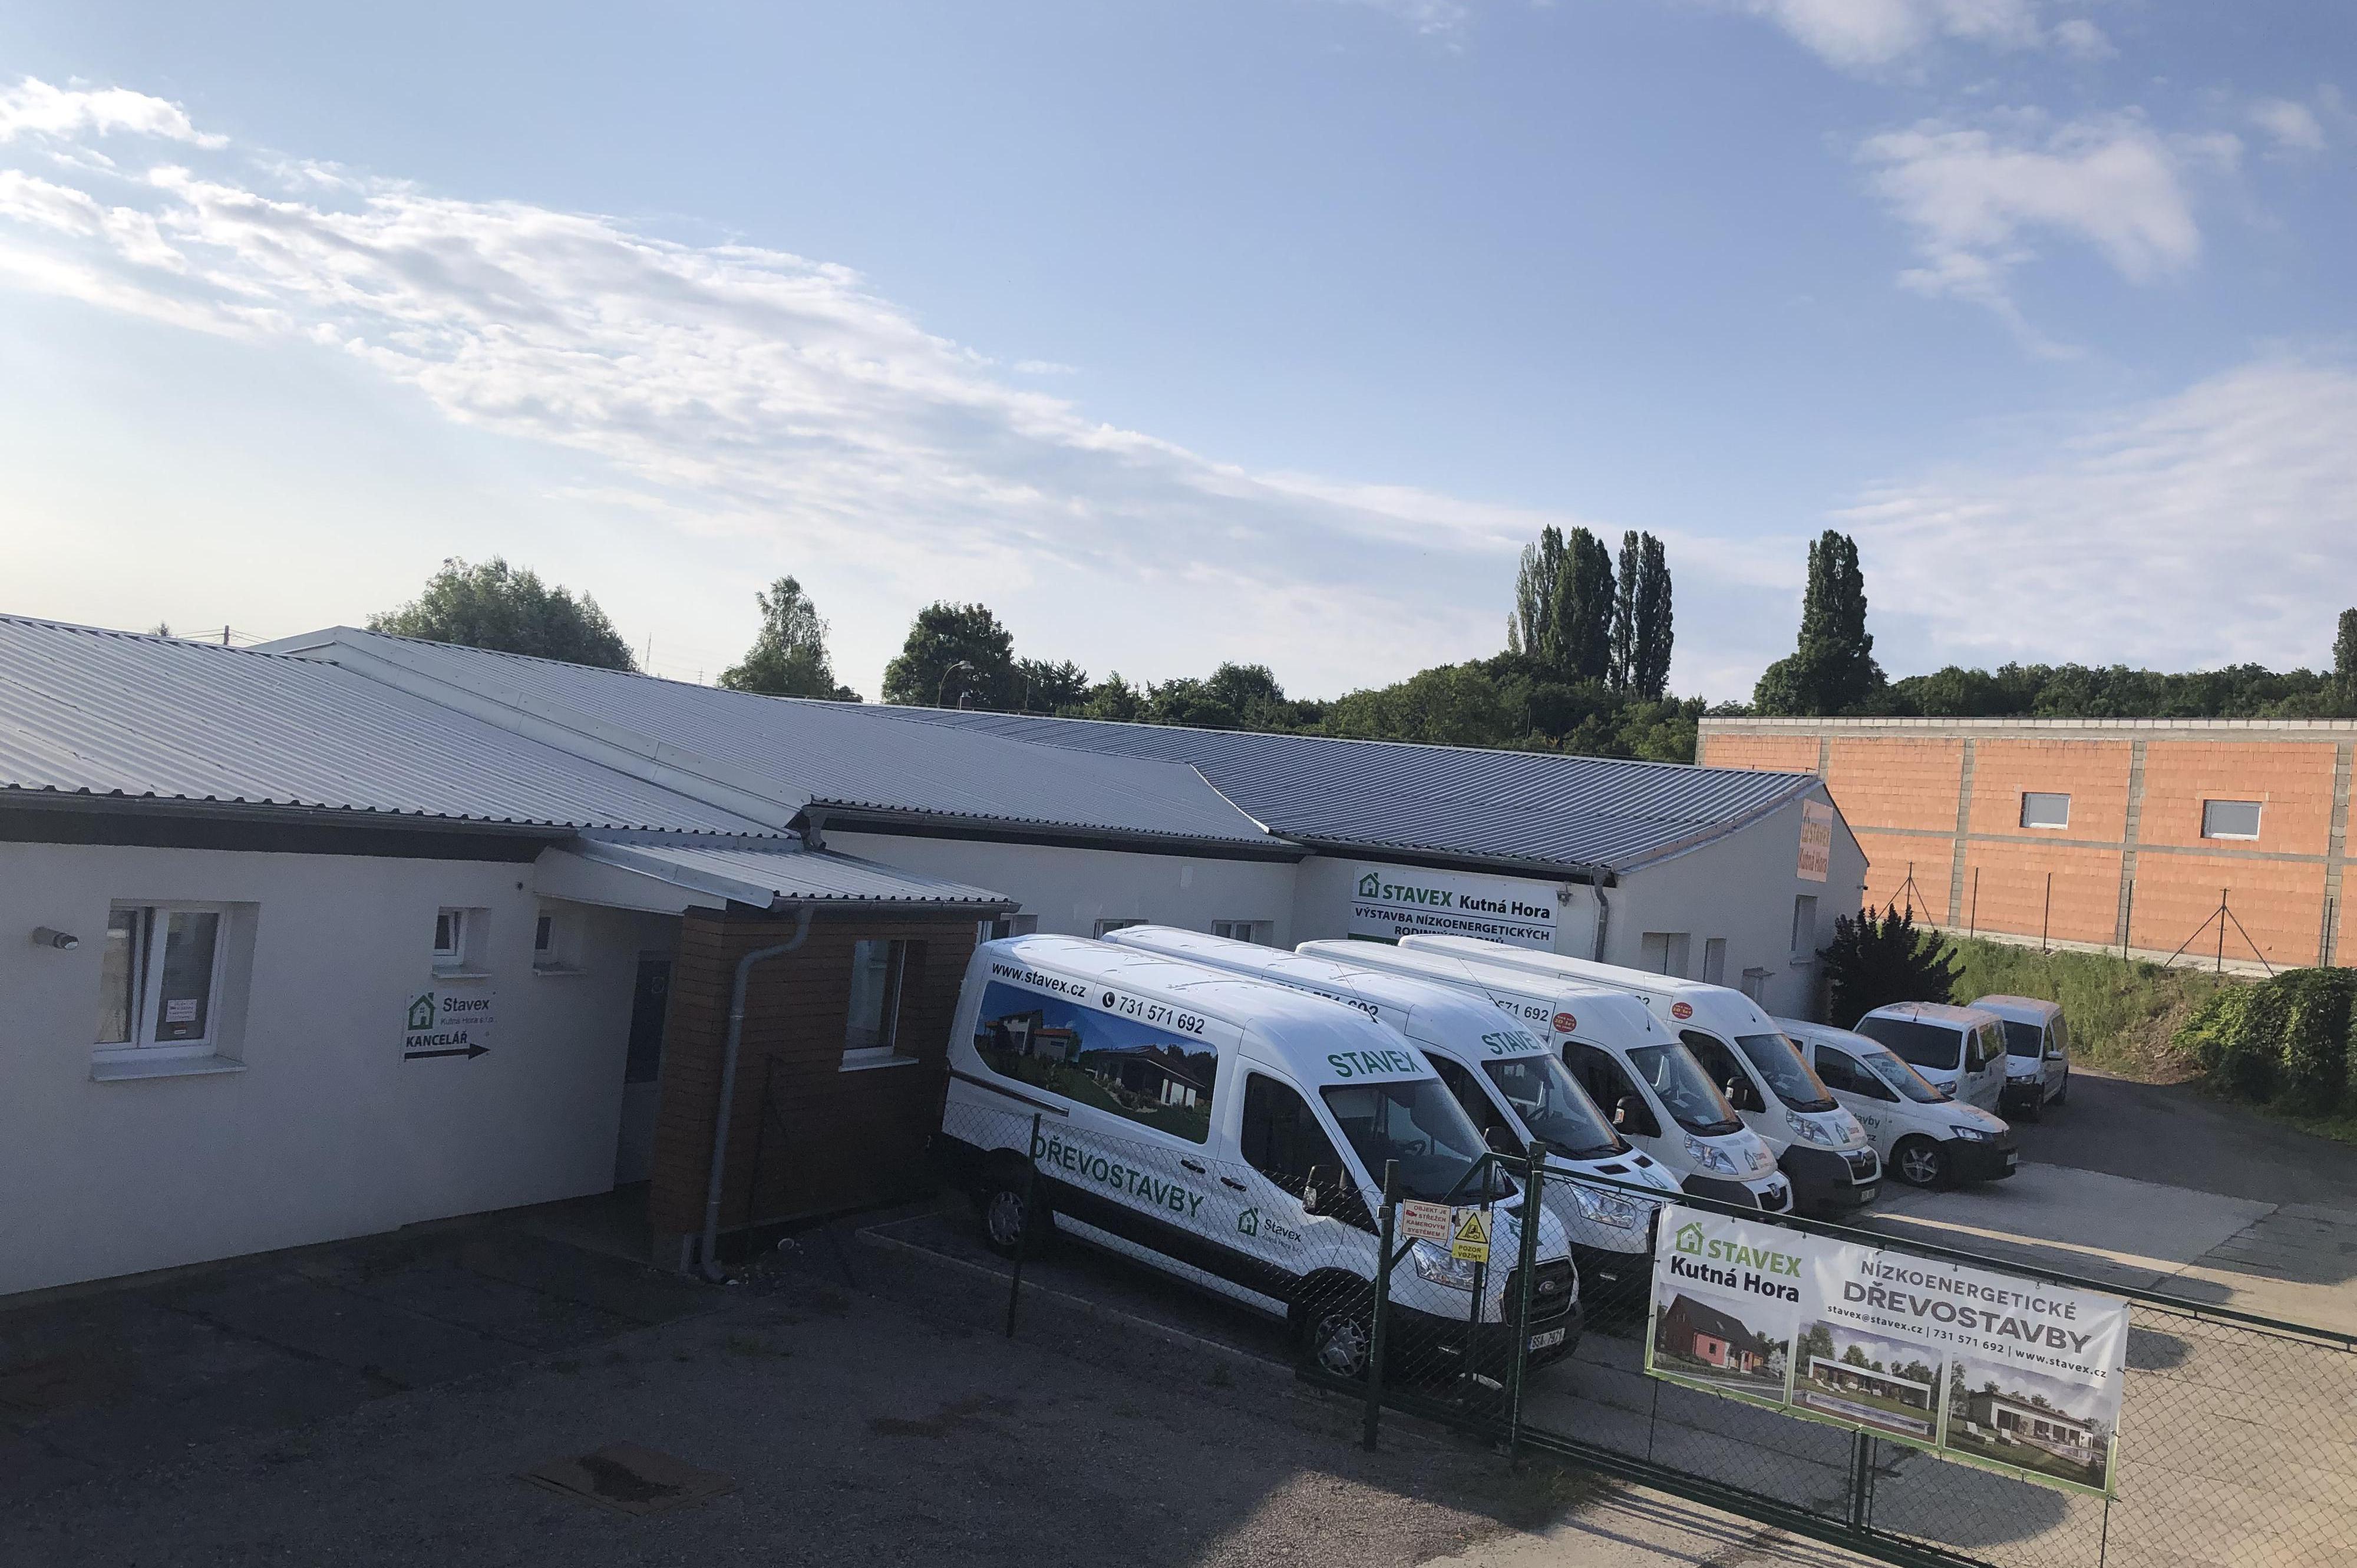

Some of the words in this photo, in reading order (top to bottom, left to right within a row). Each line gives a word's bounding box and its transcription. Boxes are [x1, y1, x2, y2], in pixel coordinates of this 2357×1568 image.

[1382, 884, 1453, 907] STAVEX
[1460, 894, 1506, 913] Kutná
[1511, 901, 1551, 919] Hora
[1355, 906, 1414, 923] VÝSTAVBA
[1416, 914, 1550, 941] NÍZKOENERGETICKÝCH
[443, 998, 490, 1012] Stavex
[992, 963, 1087, 998] www.stavex.cz
[1119, 996, 1144, 1016] 731
[1147, 1005, 1173, 1025] 571
[1177, 1014, 1205, 1035] 692
[1524, 1006, 1549, 1022] 692
[406, 1031, 467, 1047] KANCELÁŘ
[1481, 1031, 1541, 1055] STAVE
[1327, 1051, 1424, 1078] STAVEX
[1034, 1135, 1204, 1218] DŘEVOSTAVBY
[1414, 1205, 1438, 1213] OBJEKT
[1419, 1213, 1446, 1223] STŘEŽEN
[1265, 1219, 1301, 1242] Stavex
[1458, 1245, 1481, 1253] POZOR
[1708, 1239, 1802, 1278] STAVEX
[1671, 1256, 1737, 1289] Kutná
[1744, 1272, 1799, 1303] Hora
[1861, 1260, 2077, 1321] NÍZKOENERGETICKÉ
[1844, 1280, 2092, 1354] DŘEVOSTAVBY
[1827, 1305, 1923, 1334] stavex@stavex.cz
[1933, 1329, 1953, 1341] 731
[1957, 1335, 1978, 1346] 571
[1982, 1341, 2004, 1353] 692
[2015, 1349, 2107, 1378] www.stavex.cz
